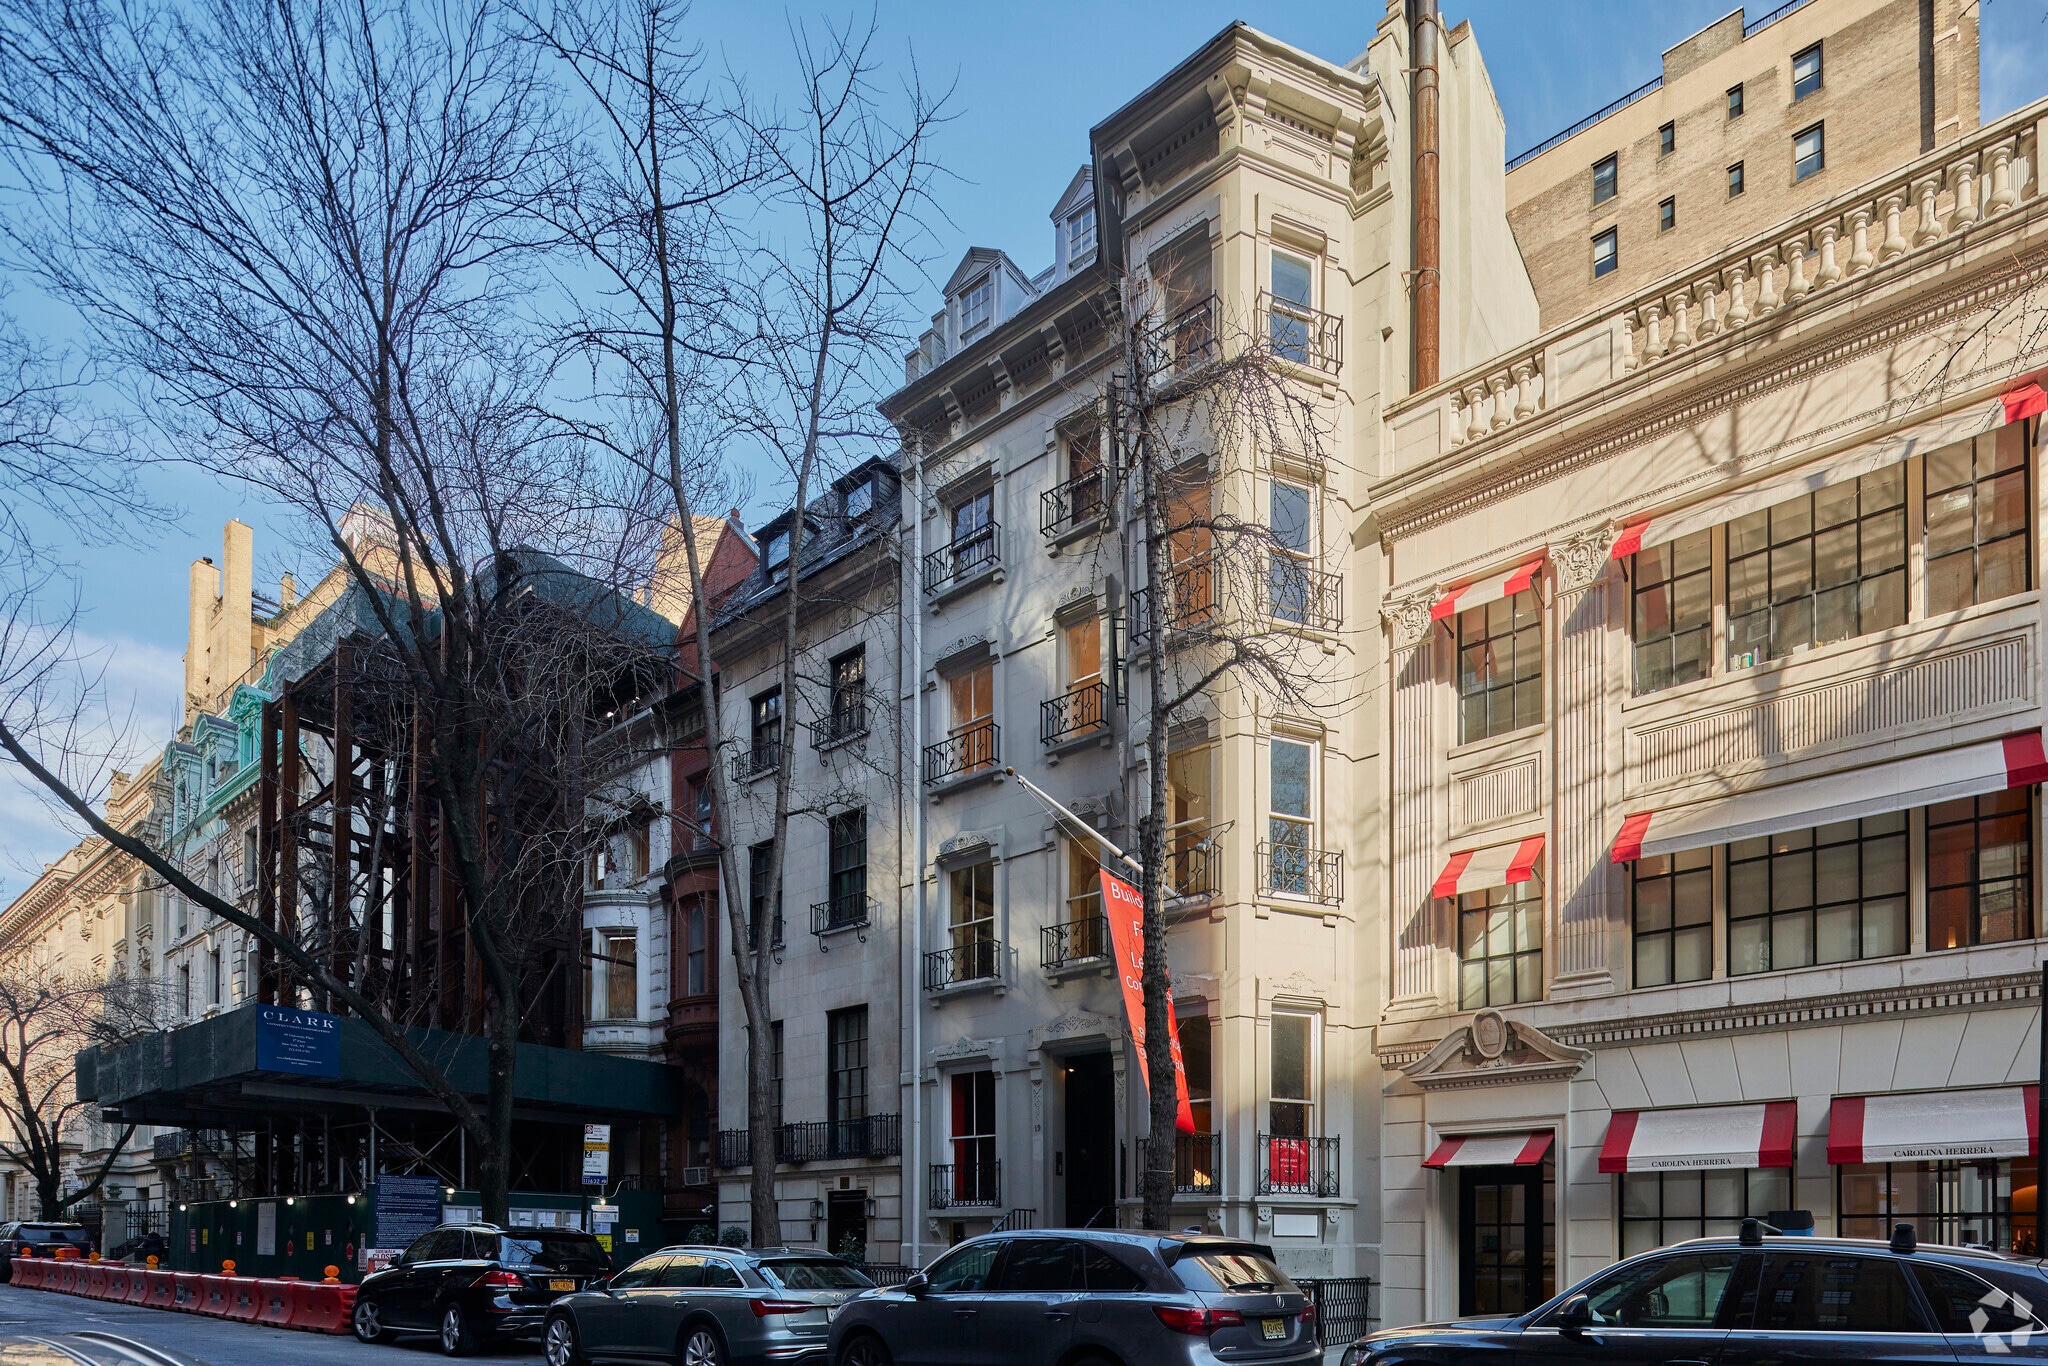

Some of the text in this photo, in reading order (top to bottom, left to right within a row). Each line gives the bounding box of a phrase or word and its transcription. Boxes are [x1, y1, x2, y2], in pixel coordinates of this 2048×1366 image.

[263, 1010, 334, 1029] CLARK
[1894, 1147, 1994, 1157] CAROLINA HERRERA
[1651, 1158, 1731, 1168] CAROLINA HERRERA
